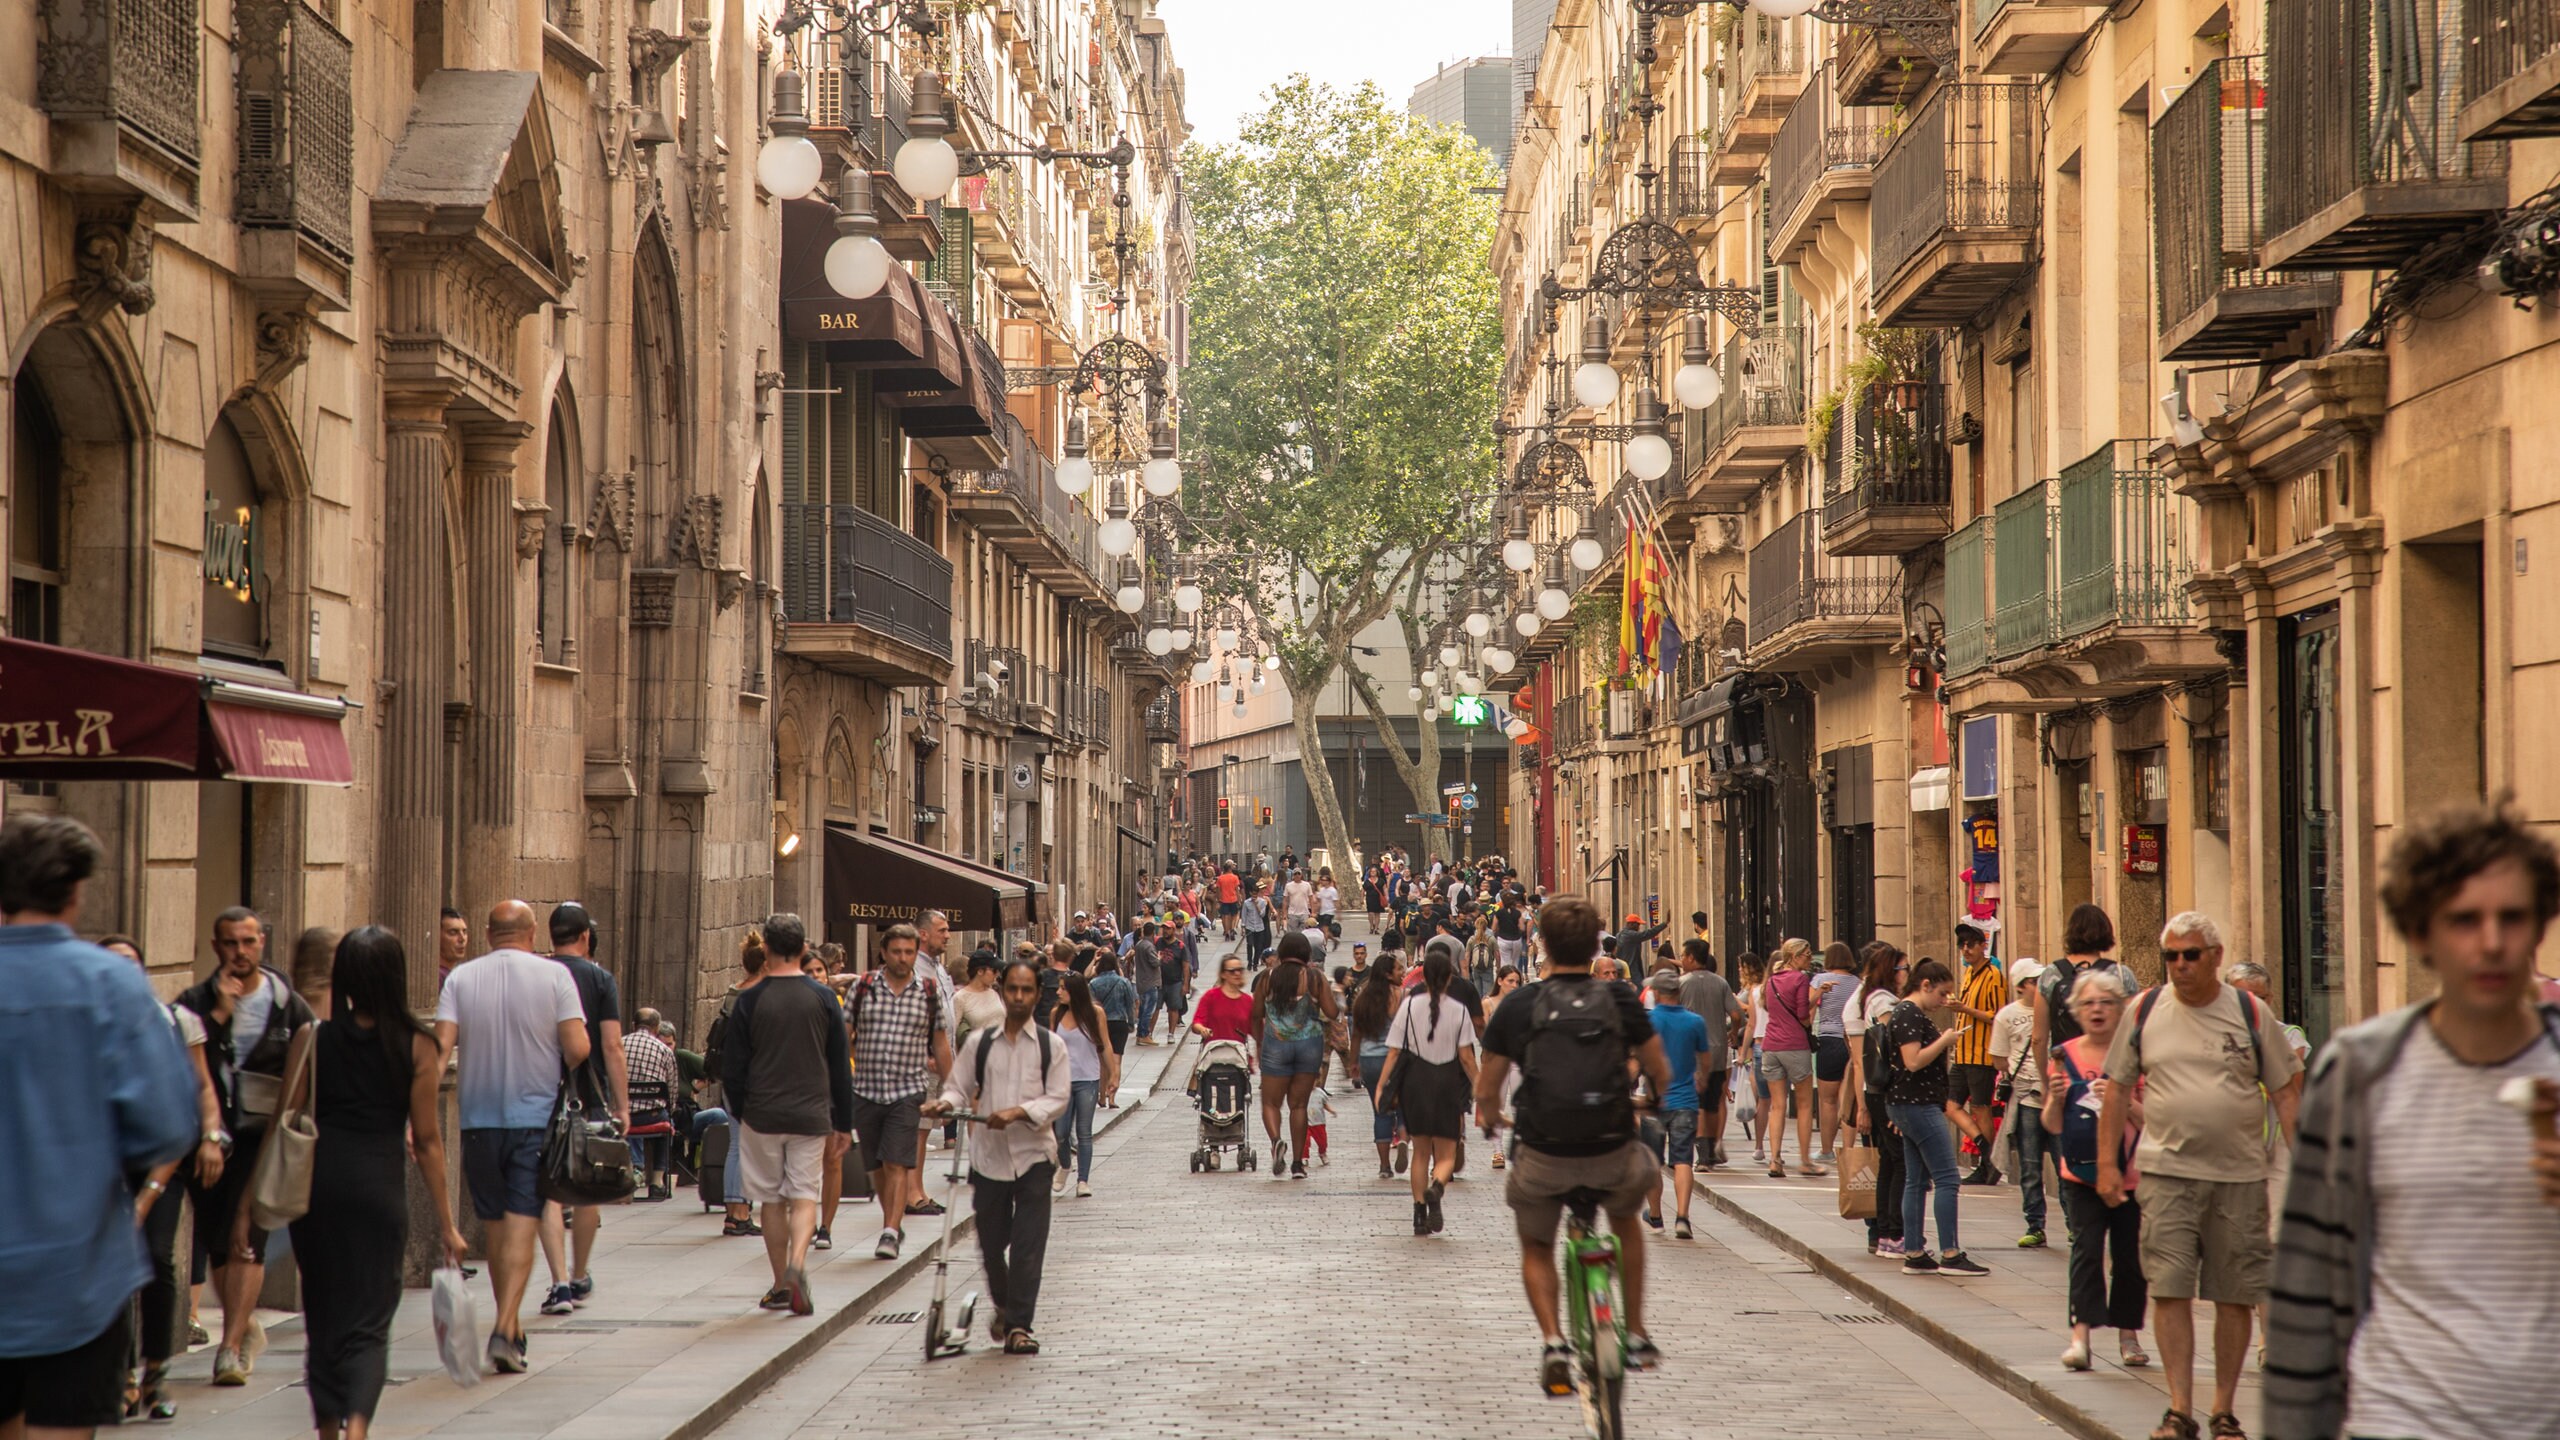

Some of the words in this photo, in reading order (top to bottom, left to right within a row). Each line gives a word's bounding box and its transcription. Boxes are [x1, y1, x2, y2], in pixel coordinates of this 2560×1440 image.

[819, 313, 860, 329] BAR
[1974, 829, 1997, 849] 14
[850, 904, 964, 922] RESTAURTE
[1846, 1181, 1877, 1191] adida
